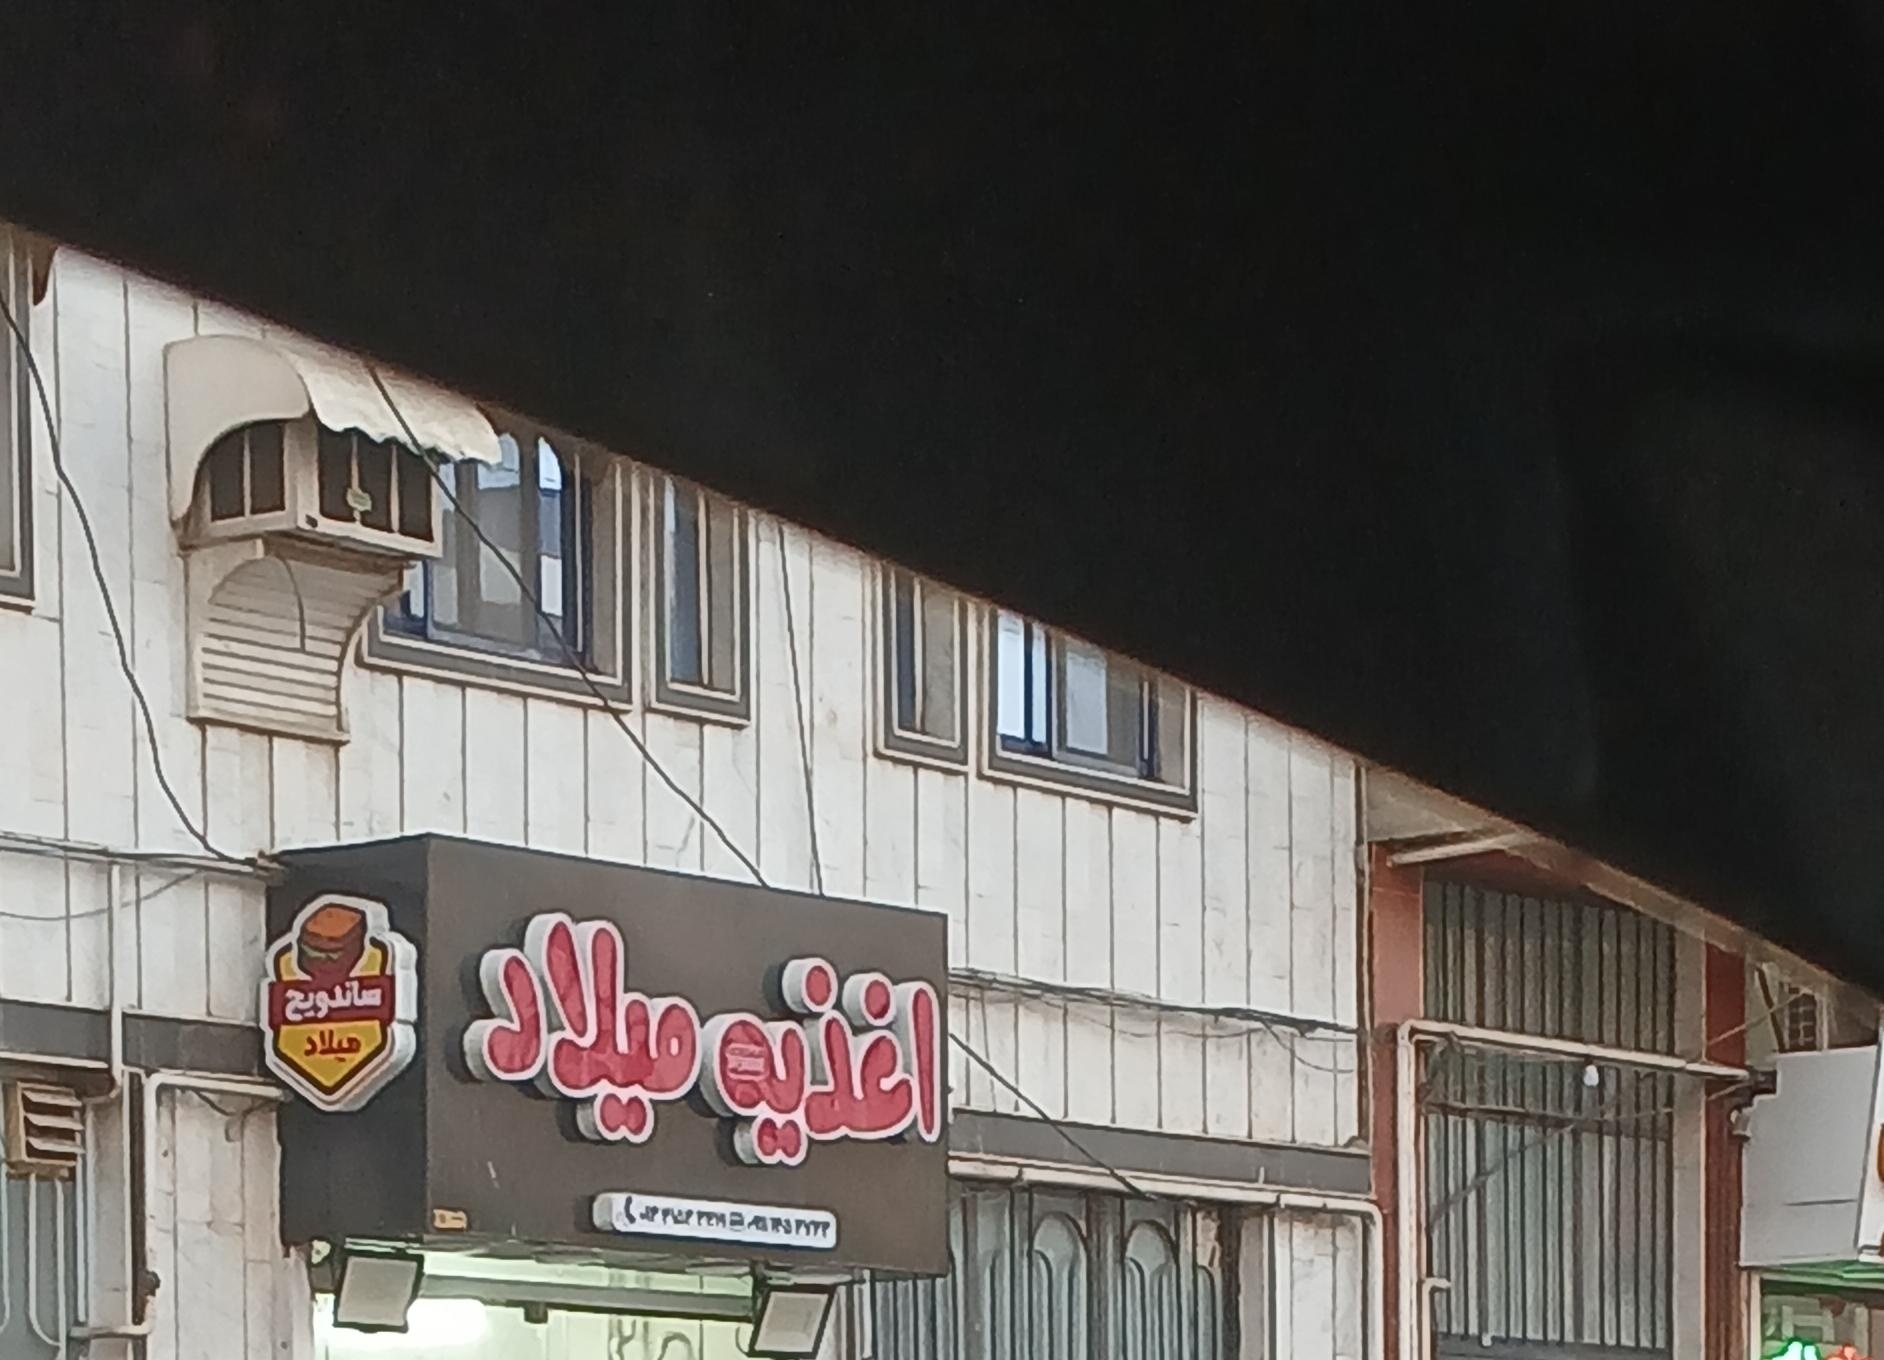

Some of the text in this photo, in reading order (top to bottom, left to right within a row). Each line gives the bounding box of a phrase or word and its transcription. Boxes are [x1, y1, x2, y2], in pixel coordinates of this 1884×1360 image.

[304, 1029, 362, 1063] میلاد
[474, 914, 941, 1164] اغذیه میلاد
